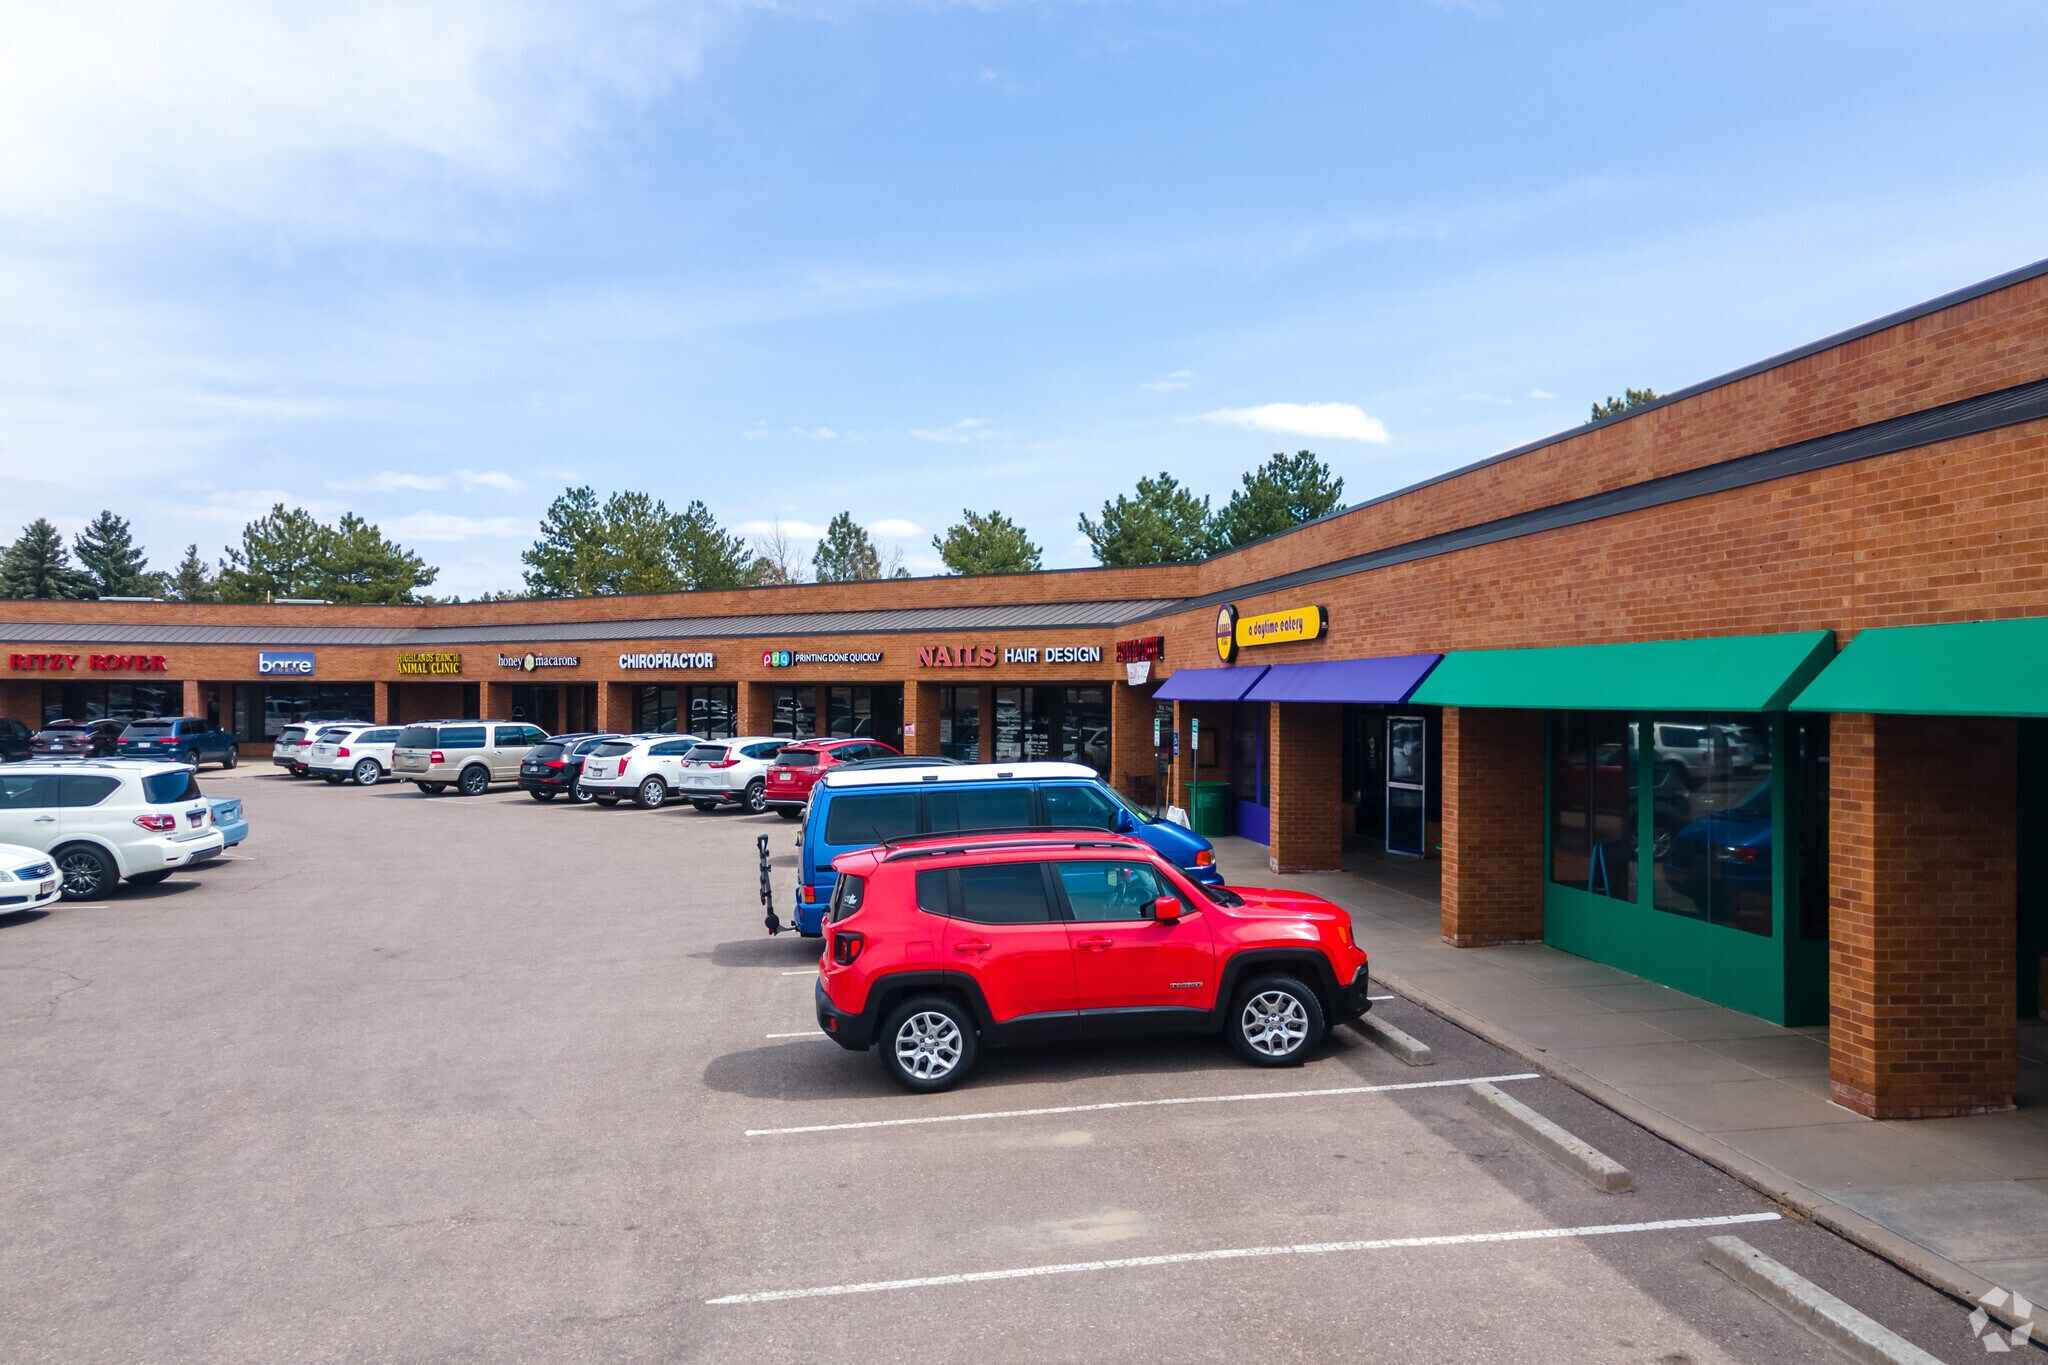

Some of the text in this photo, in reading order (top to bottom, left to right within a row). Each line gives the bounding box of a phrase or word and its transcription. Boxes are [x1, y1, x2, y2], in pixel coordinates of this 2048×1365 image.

[1248, 625, 1253, 636] a
[1254, 618, 1278, 638] daytime
[1280, 616, 1303, 634] eatery
[10, 654, 167, 671] RITZY ROVER
[259, 653, 312, 673] barre
[398, 653, 459, 662] HIGHLANDS RANCH
[498, 653, 523, 671] honey
[535, 656, 577, 666] macarons
[619, 653, 714, 669] CHIROPRACTOR
[795, 652, 881, 663] PRINTING DONE QUICKLY
[916, 645, 997, 667] NAILS
[1004, 648, 1038, 663] HAIR
[1045, 647, 1101, 662] DESIGN
[397, 662, 459, 674] ANIMAL CLINIC
